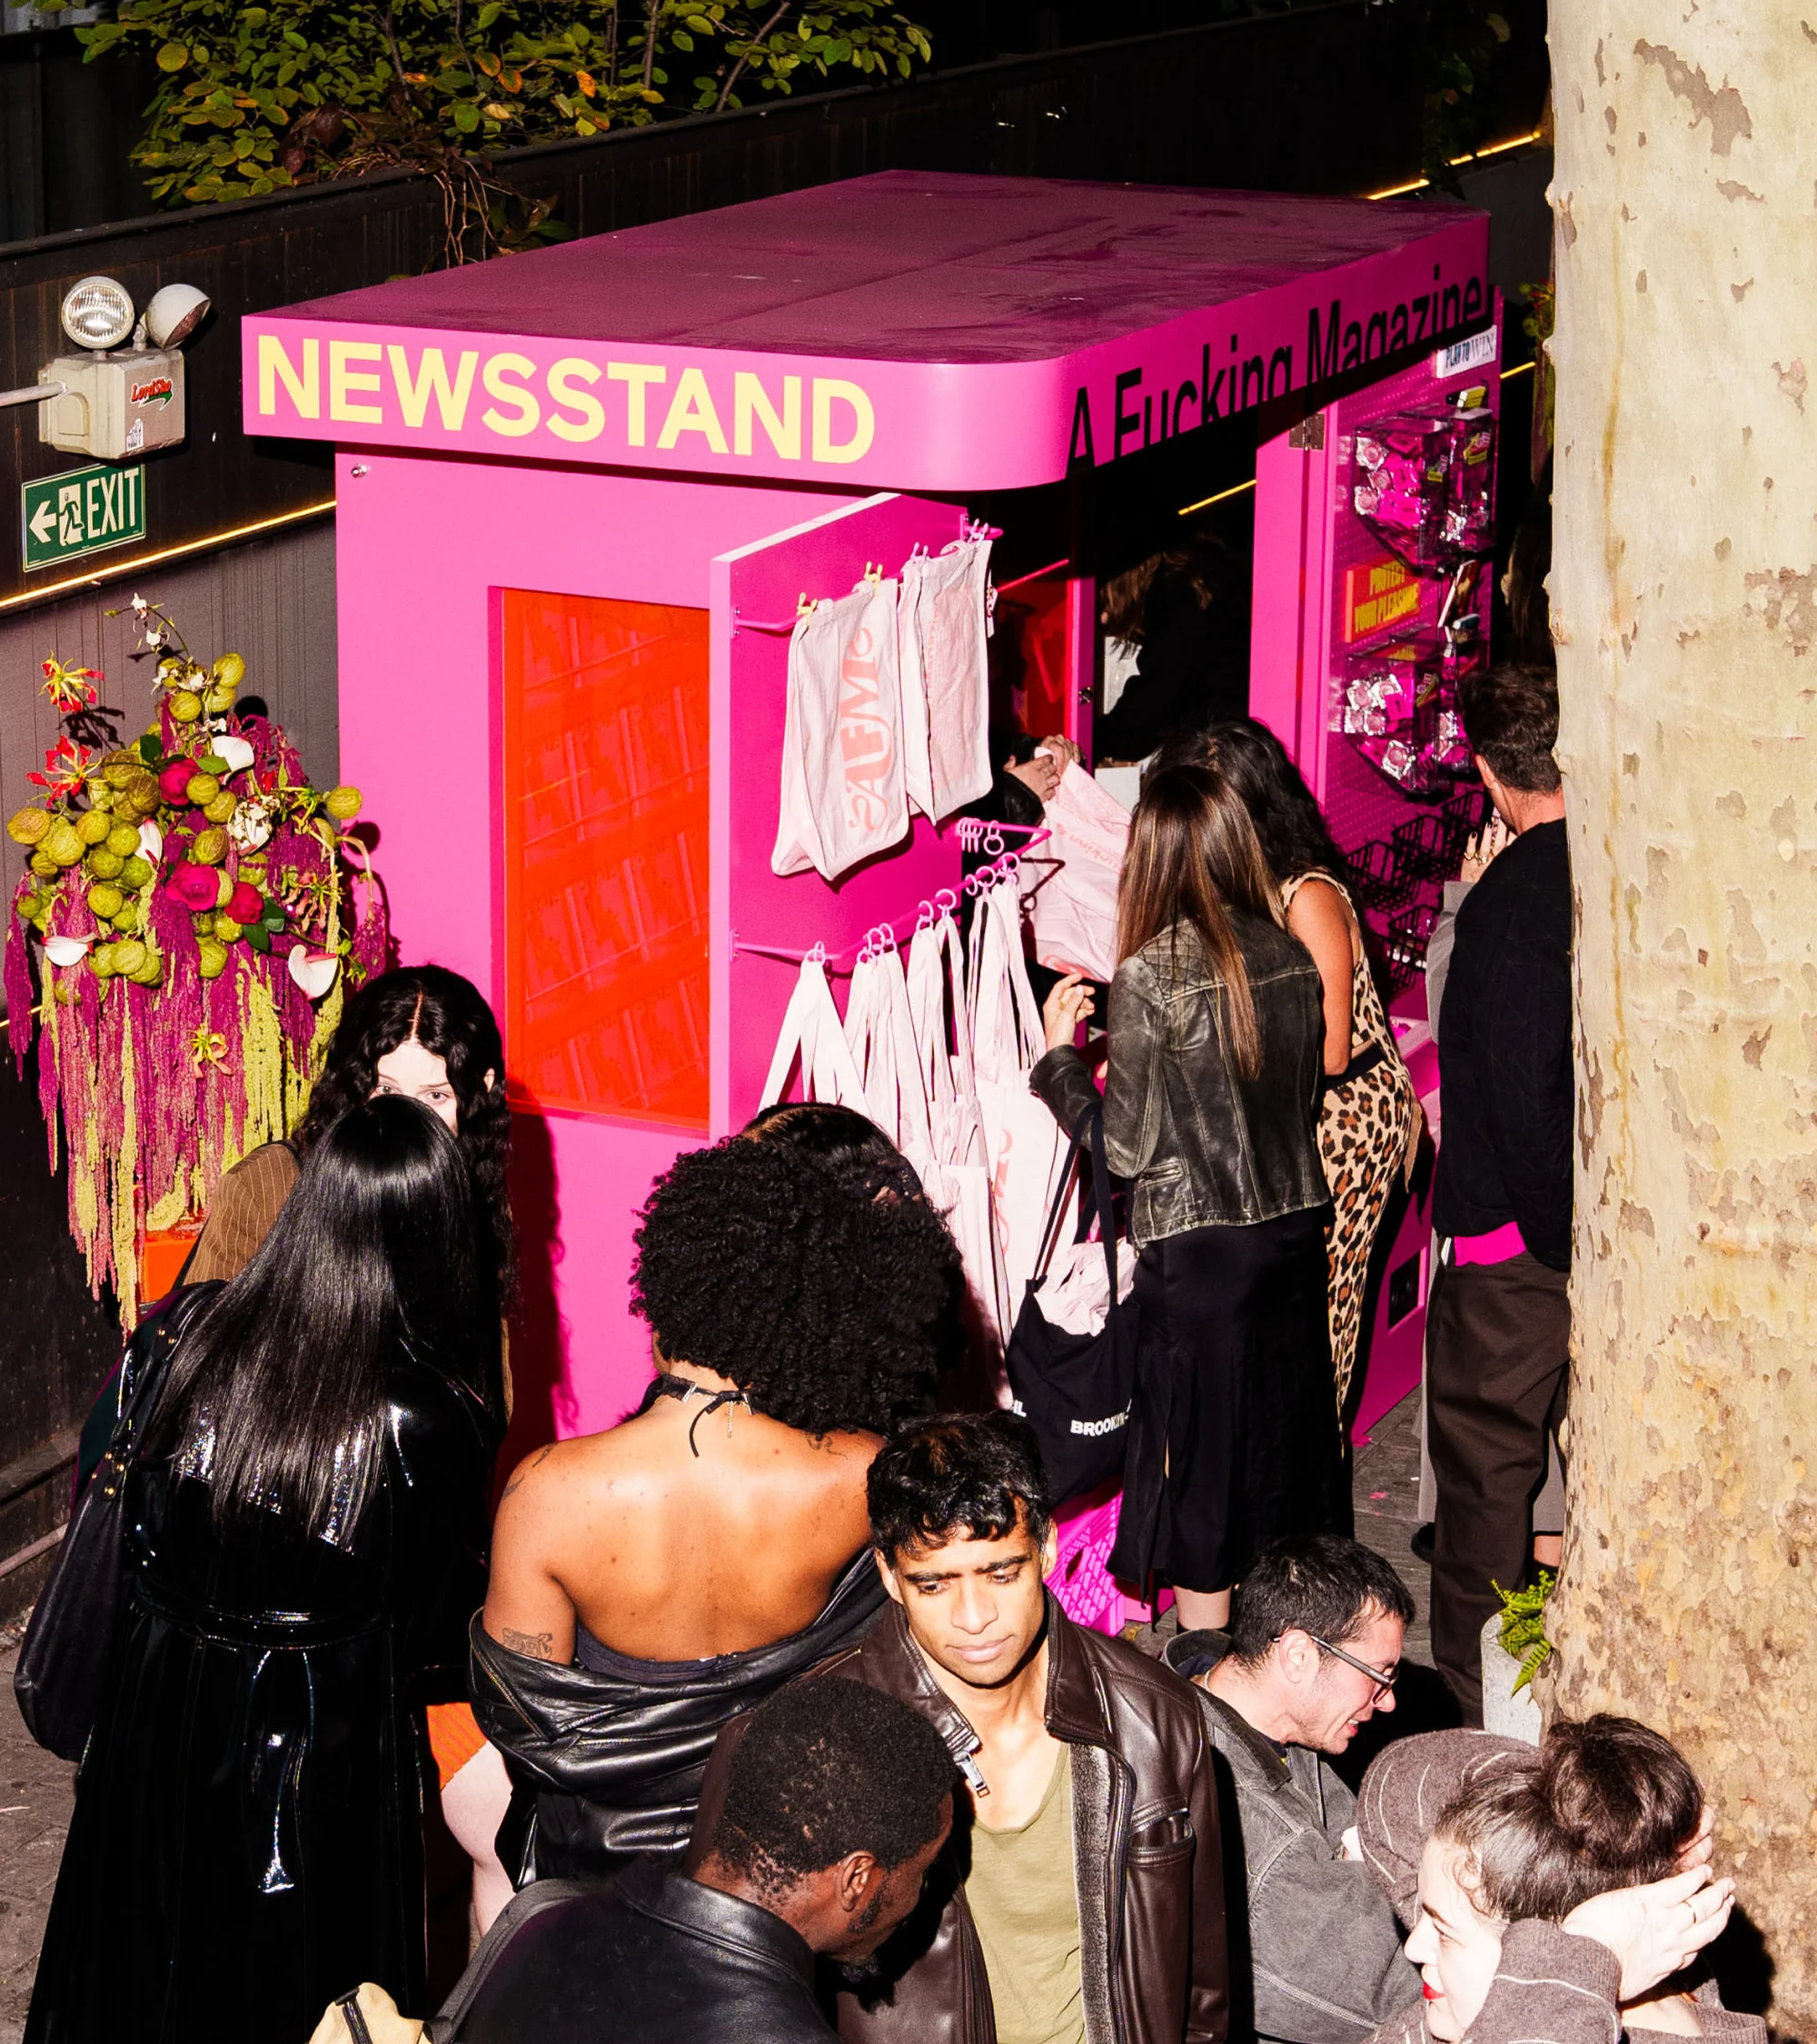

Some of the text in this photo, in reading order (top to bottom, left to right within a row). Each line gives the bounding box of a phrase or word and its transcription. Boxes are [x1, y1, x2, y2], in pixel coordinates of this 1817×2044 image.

[257, 334, 876, 465] NEWSSTAND
[1066, 385, 1096, 479] A
[86, 467, 139, 540] EXIT
